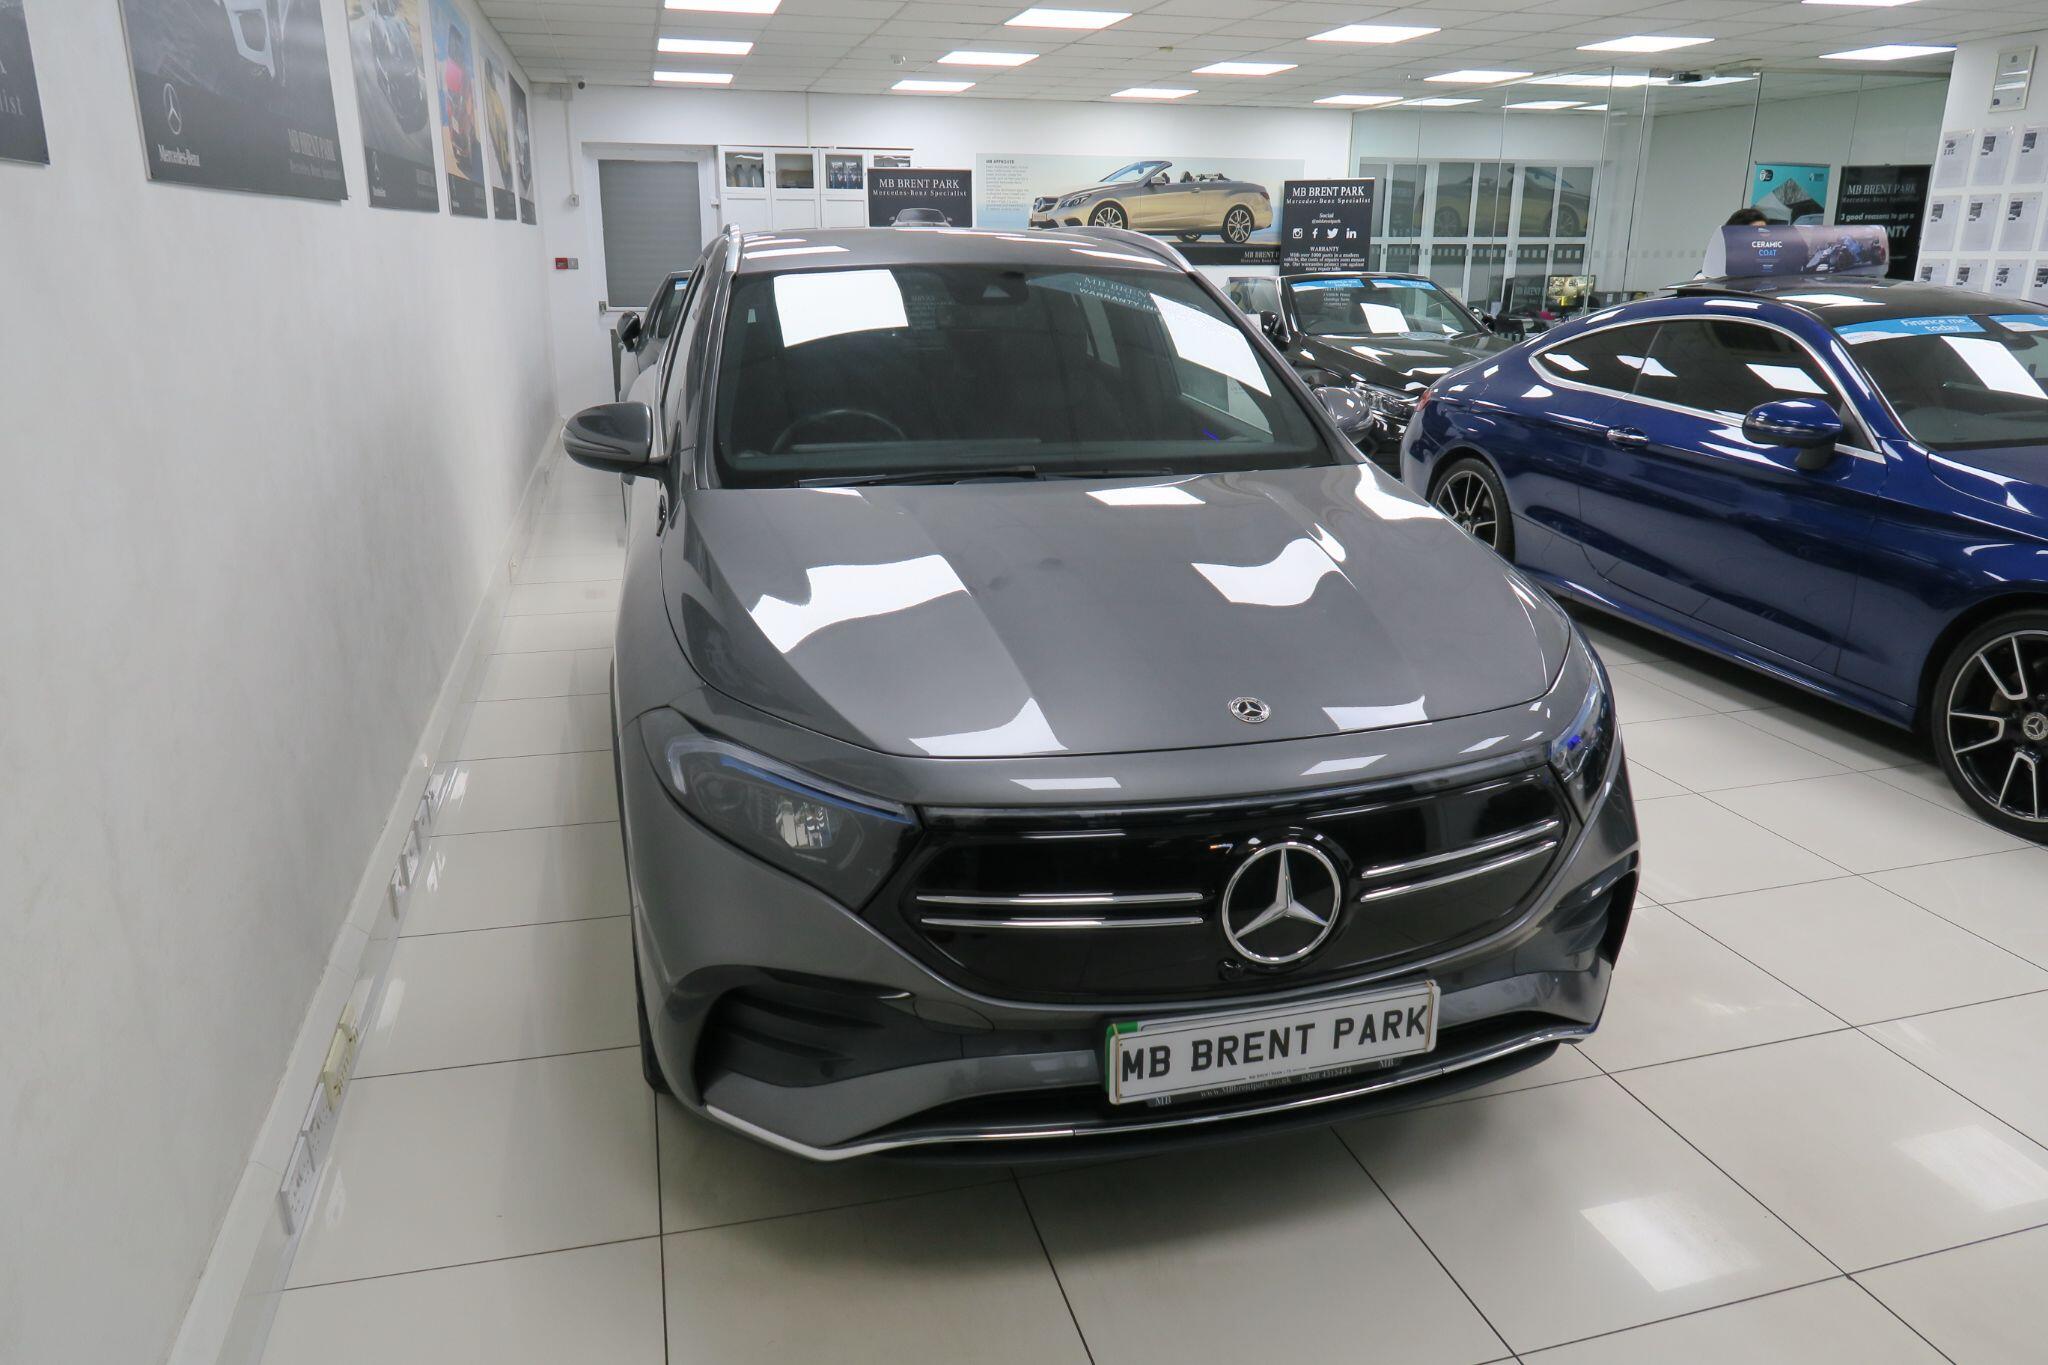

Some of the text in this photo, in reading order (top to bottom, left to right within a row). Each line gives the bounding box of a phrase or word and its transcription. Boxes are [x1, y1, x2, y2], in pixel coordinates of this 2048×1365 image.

[879, 178, 960, 189] MB BRENT PARK
[1847, 183, 1917, 195] MB BRENT PARK
[1292, 186, 1365, 197] MB BRENT PARK
[1840, 213, 1846, 221] 3
[1846, 212, 1864, 222] good
[1898, 212, 1909, 221] get
[1346, 228, 1357, 239] in
[1751, 240, 1783, 248] CERAMIC
[1758, 249, 1777, 257] COAT
[1079, 288, 1140, 306] WARRANTY
[1900, 318, 1944, 327] Finance
[1925, 325, 1960, 333] today
[1121, 1004, 1428, 1082] MB BRENT PARK
